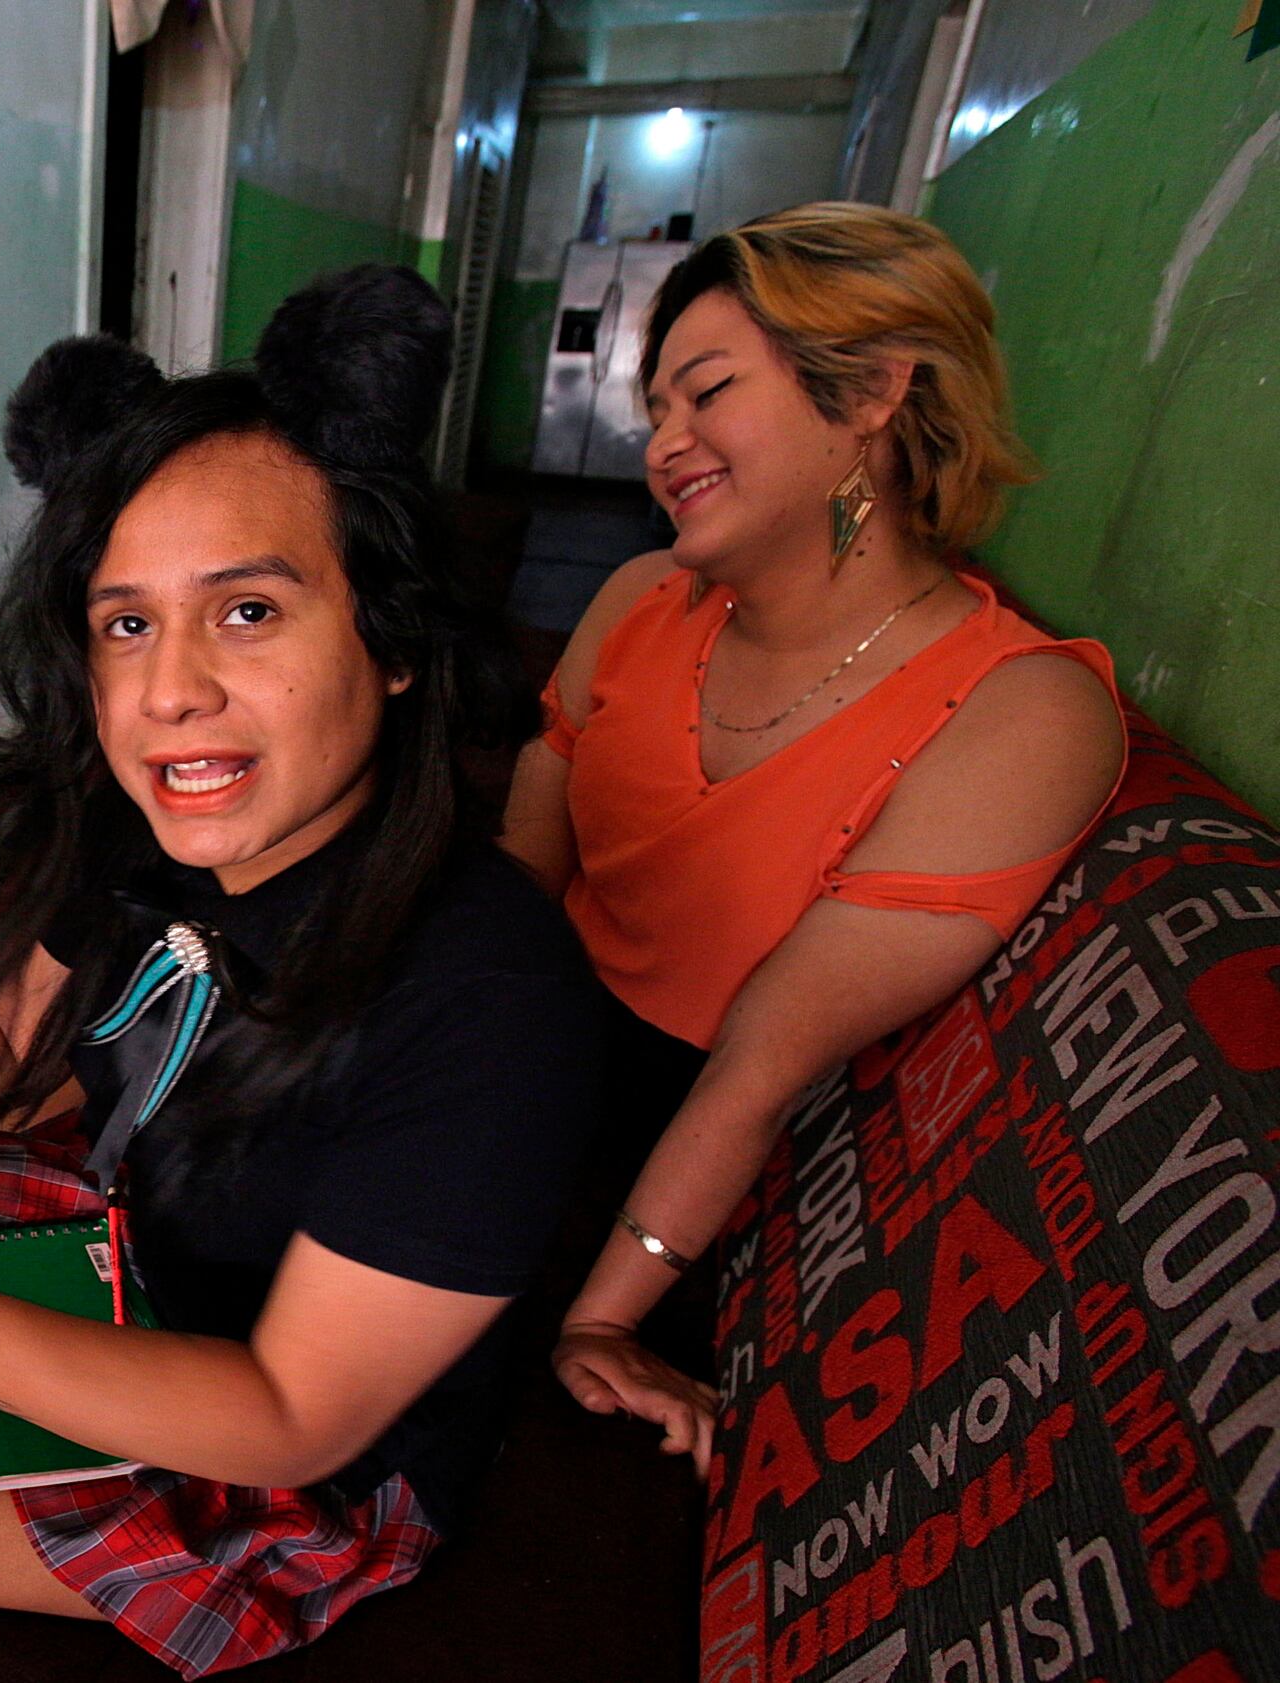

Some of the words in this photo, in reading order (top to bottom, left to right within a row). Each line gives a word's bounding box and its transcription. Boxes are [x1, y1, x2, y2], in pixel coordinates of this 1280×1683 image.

[982, 863, 1085, 1003] NOW
[1033, 922, 1202, 1146] NEW
[1144, 885, 1280, 968] pu
[795, 1105, 867, 1328] YORK
[1018, 1100, 1106, 1283] TODAY
[1075, 1280, 1149, 1387] UP
[767, 1403, 1077, 1683] amour
[772, 1467, 896, 1619] NOW
[907, 1310, 1062, 1490] WOW
[1103, 1366, 1233, 1611] SIGN
